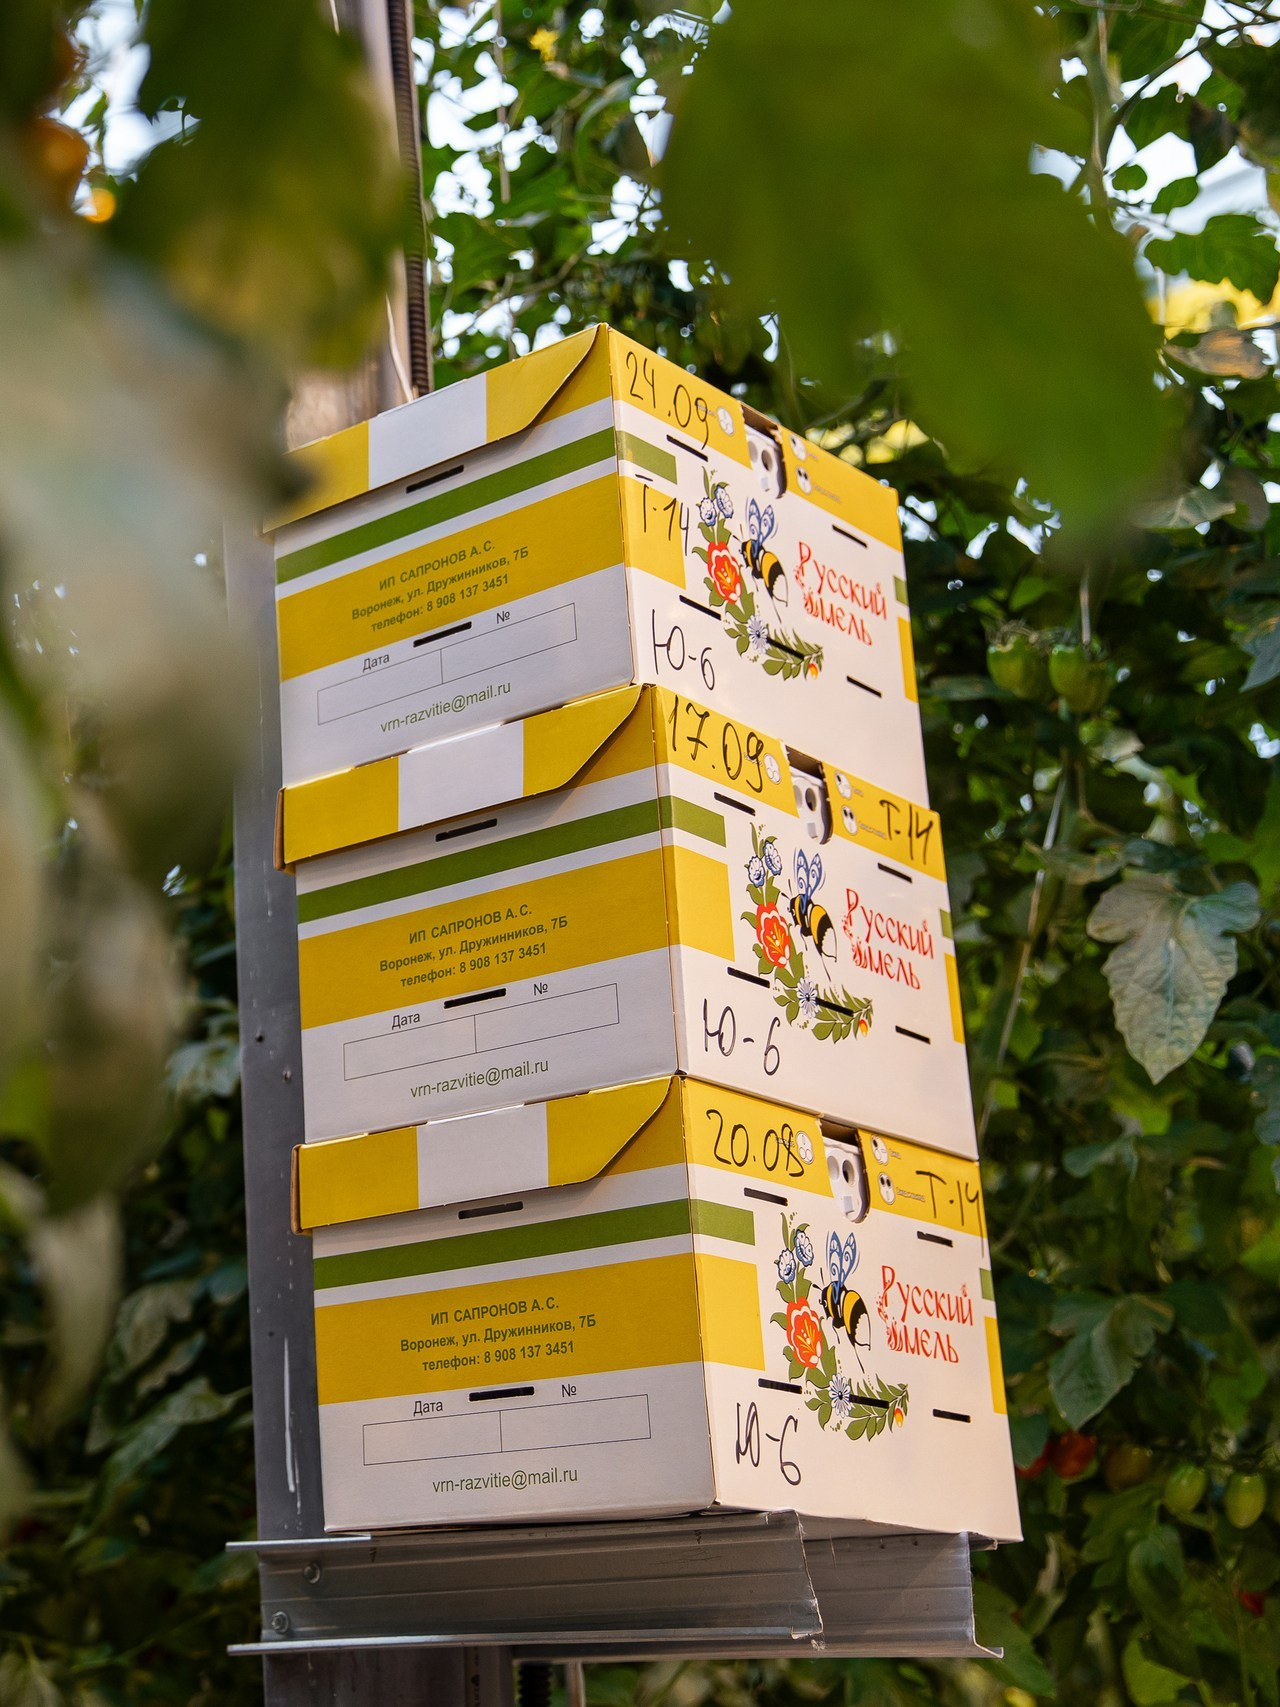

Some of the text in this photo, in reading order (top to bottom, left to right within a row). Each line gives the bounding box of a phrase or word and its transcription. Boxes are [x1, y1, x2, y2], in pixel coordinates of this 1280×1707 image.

[626, 351, 709, 450] 24.09
[352, 547, 529, 619] Воронеж, ул. Дружинников, 7Б
[379, 540, 495, 591] ИП САПРОНОВ А. С.
[371, 574, 508, 631] телефон: 8 908 137 3451
[496, 611, 510, 624] №
[363, 652, 390, 673] Дата
[652, 608, 715, 691] Ю-6
[380, 681, 511, 733] vrn-razvitie@mail.ru
[668, 695, 764, 793] 17.09
[380, 916, 568, 971] Воронеж, ул. Дружинников, 7Б
[409, 904, 532, 944] ИП САПРОНОВ А. С.
[400, 943, 546, 987] телефон: 8 908 137 3451
[533, 983, 548, 996] №
[392, 1011, 420, 1030] Дата
[703, 998, 780, 1076] Ю-6
[411, 1057, 549, 1098] vrn-razvitie@mail.ru
[431, 1297, 559, 1325] ИП САПРОНОВ А. С.
[877, 1265, 973, 1326] Русский
[401, 1314, 596, 1352] Воронеж, ул. Дружинников, 7Б
[423, 1340, 574, 1371] телефон: 8 908 137 3451
[413, 1400, 443, 1416] Дата
[562, 1384, 577, 1397] №
[433, 1467, 578, 1493] vrn-razvitie@mail.ru
